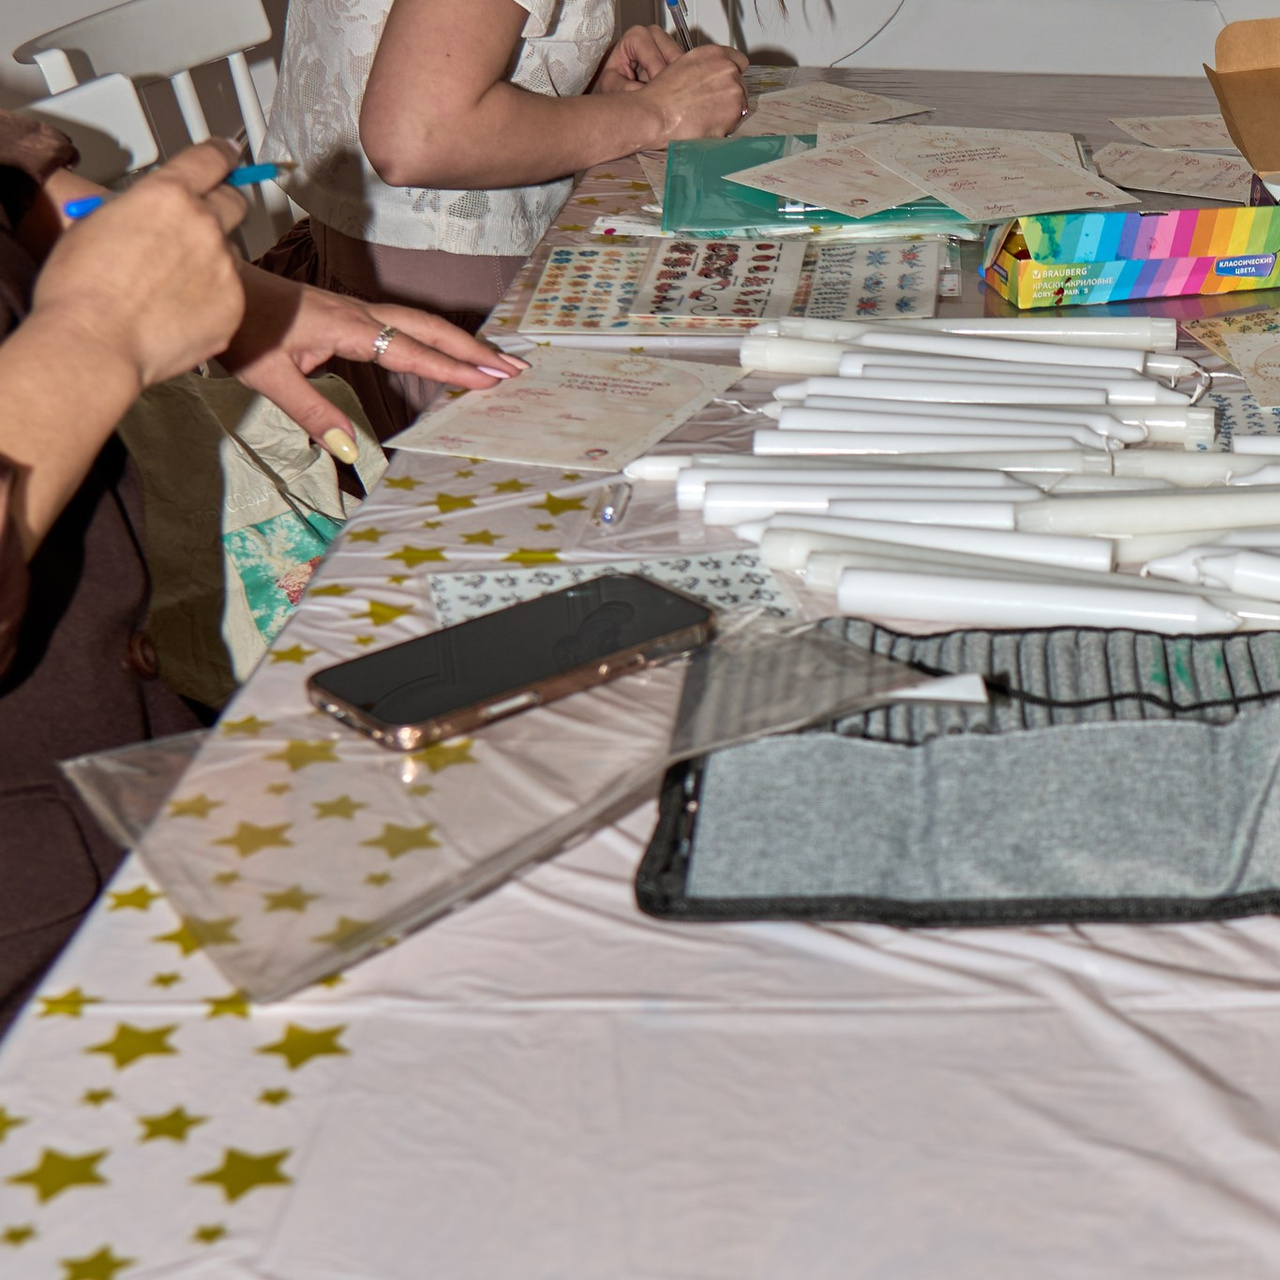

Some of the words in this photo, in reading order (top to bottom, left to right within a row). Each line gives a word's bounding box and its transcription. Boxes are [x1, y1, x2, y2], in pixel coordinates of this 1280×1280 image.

[1218, 256, 1273, 268] КЛАССИЧЕСКИЕ
[1042, 268, 1088, 278] BRAUBERG
[1234, 266, 1256, 275] ЦВЕТА
[1032, 281, 1064, 290] КРАСКИ
[1065, 277, 1114, 288] АКРИЛОВЫЕ
